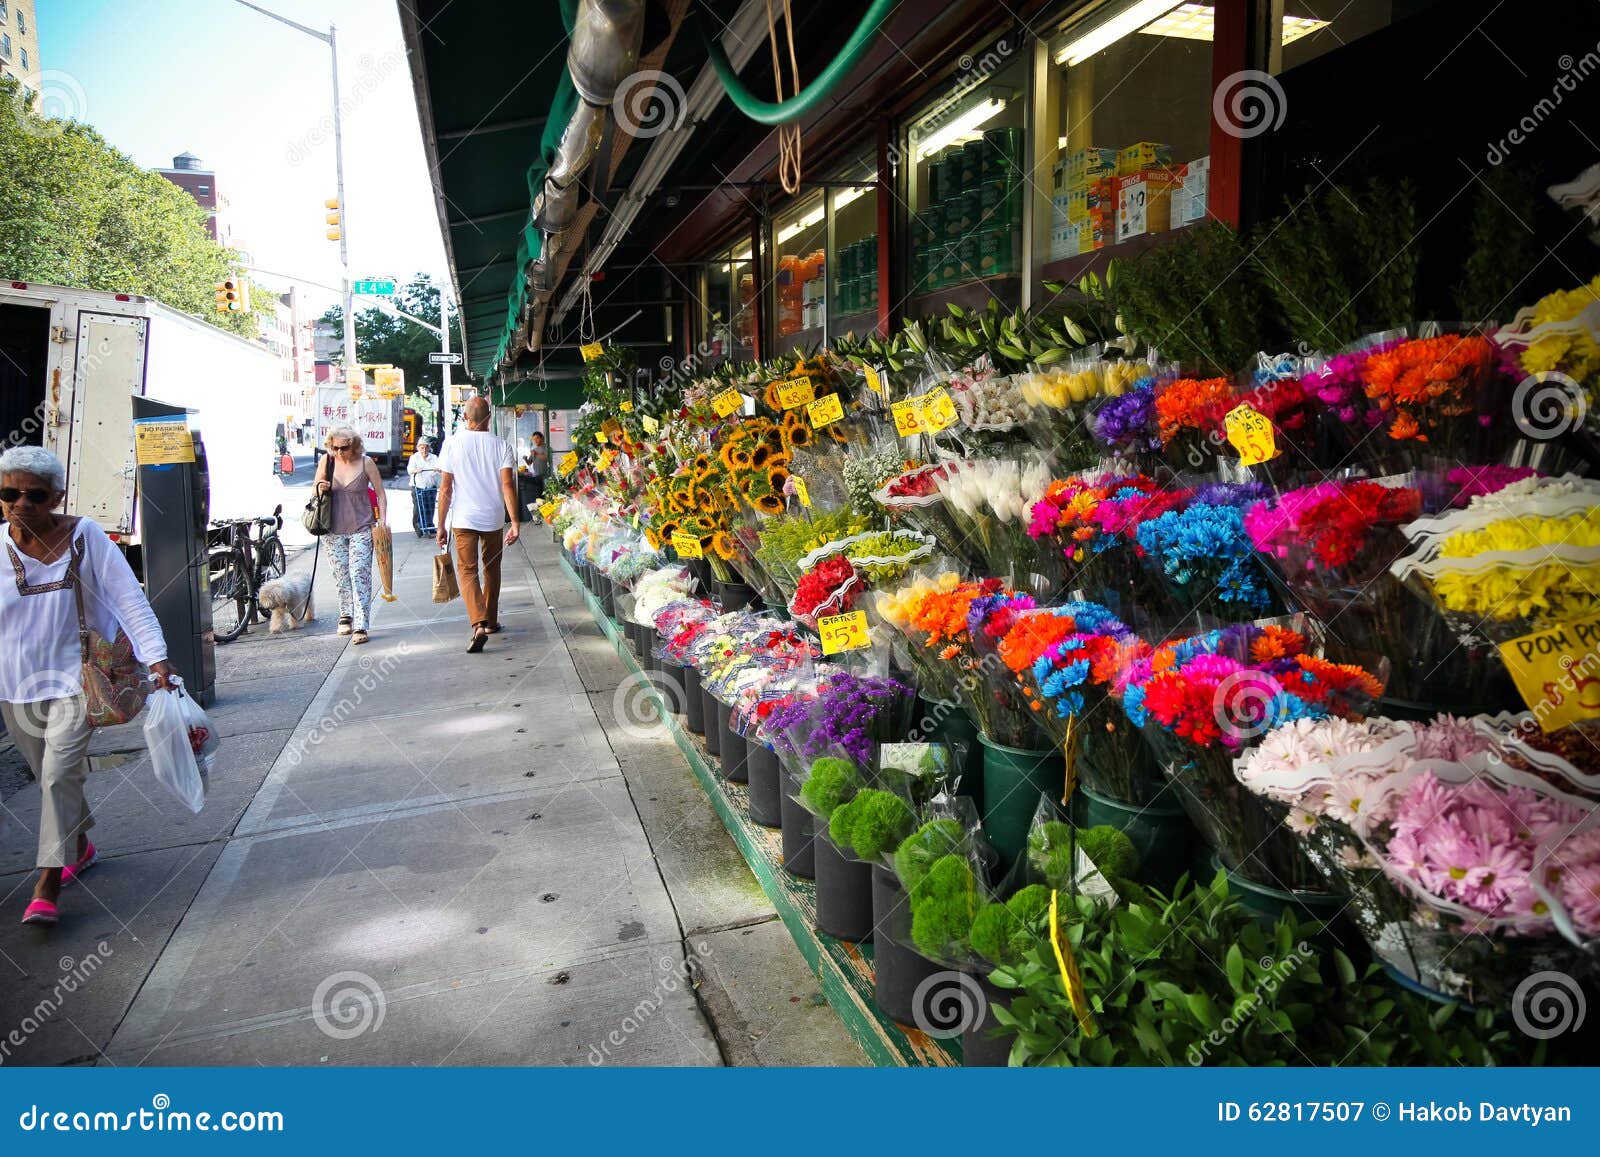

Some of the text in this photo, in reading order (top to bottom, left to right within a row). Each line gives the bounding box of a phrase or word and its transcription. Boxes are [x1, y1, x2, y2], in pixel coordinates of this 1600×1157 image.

[360, 282, 366, 294] E
[369, 282, 378, 294] 4
[1516, 630, 1574, 664] POM
